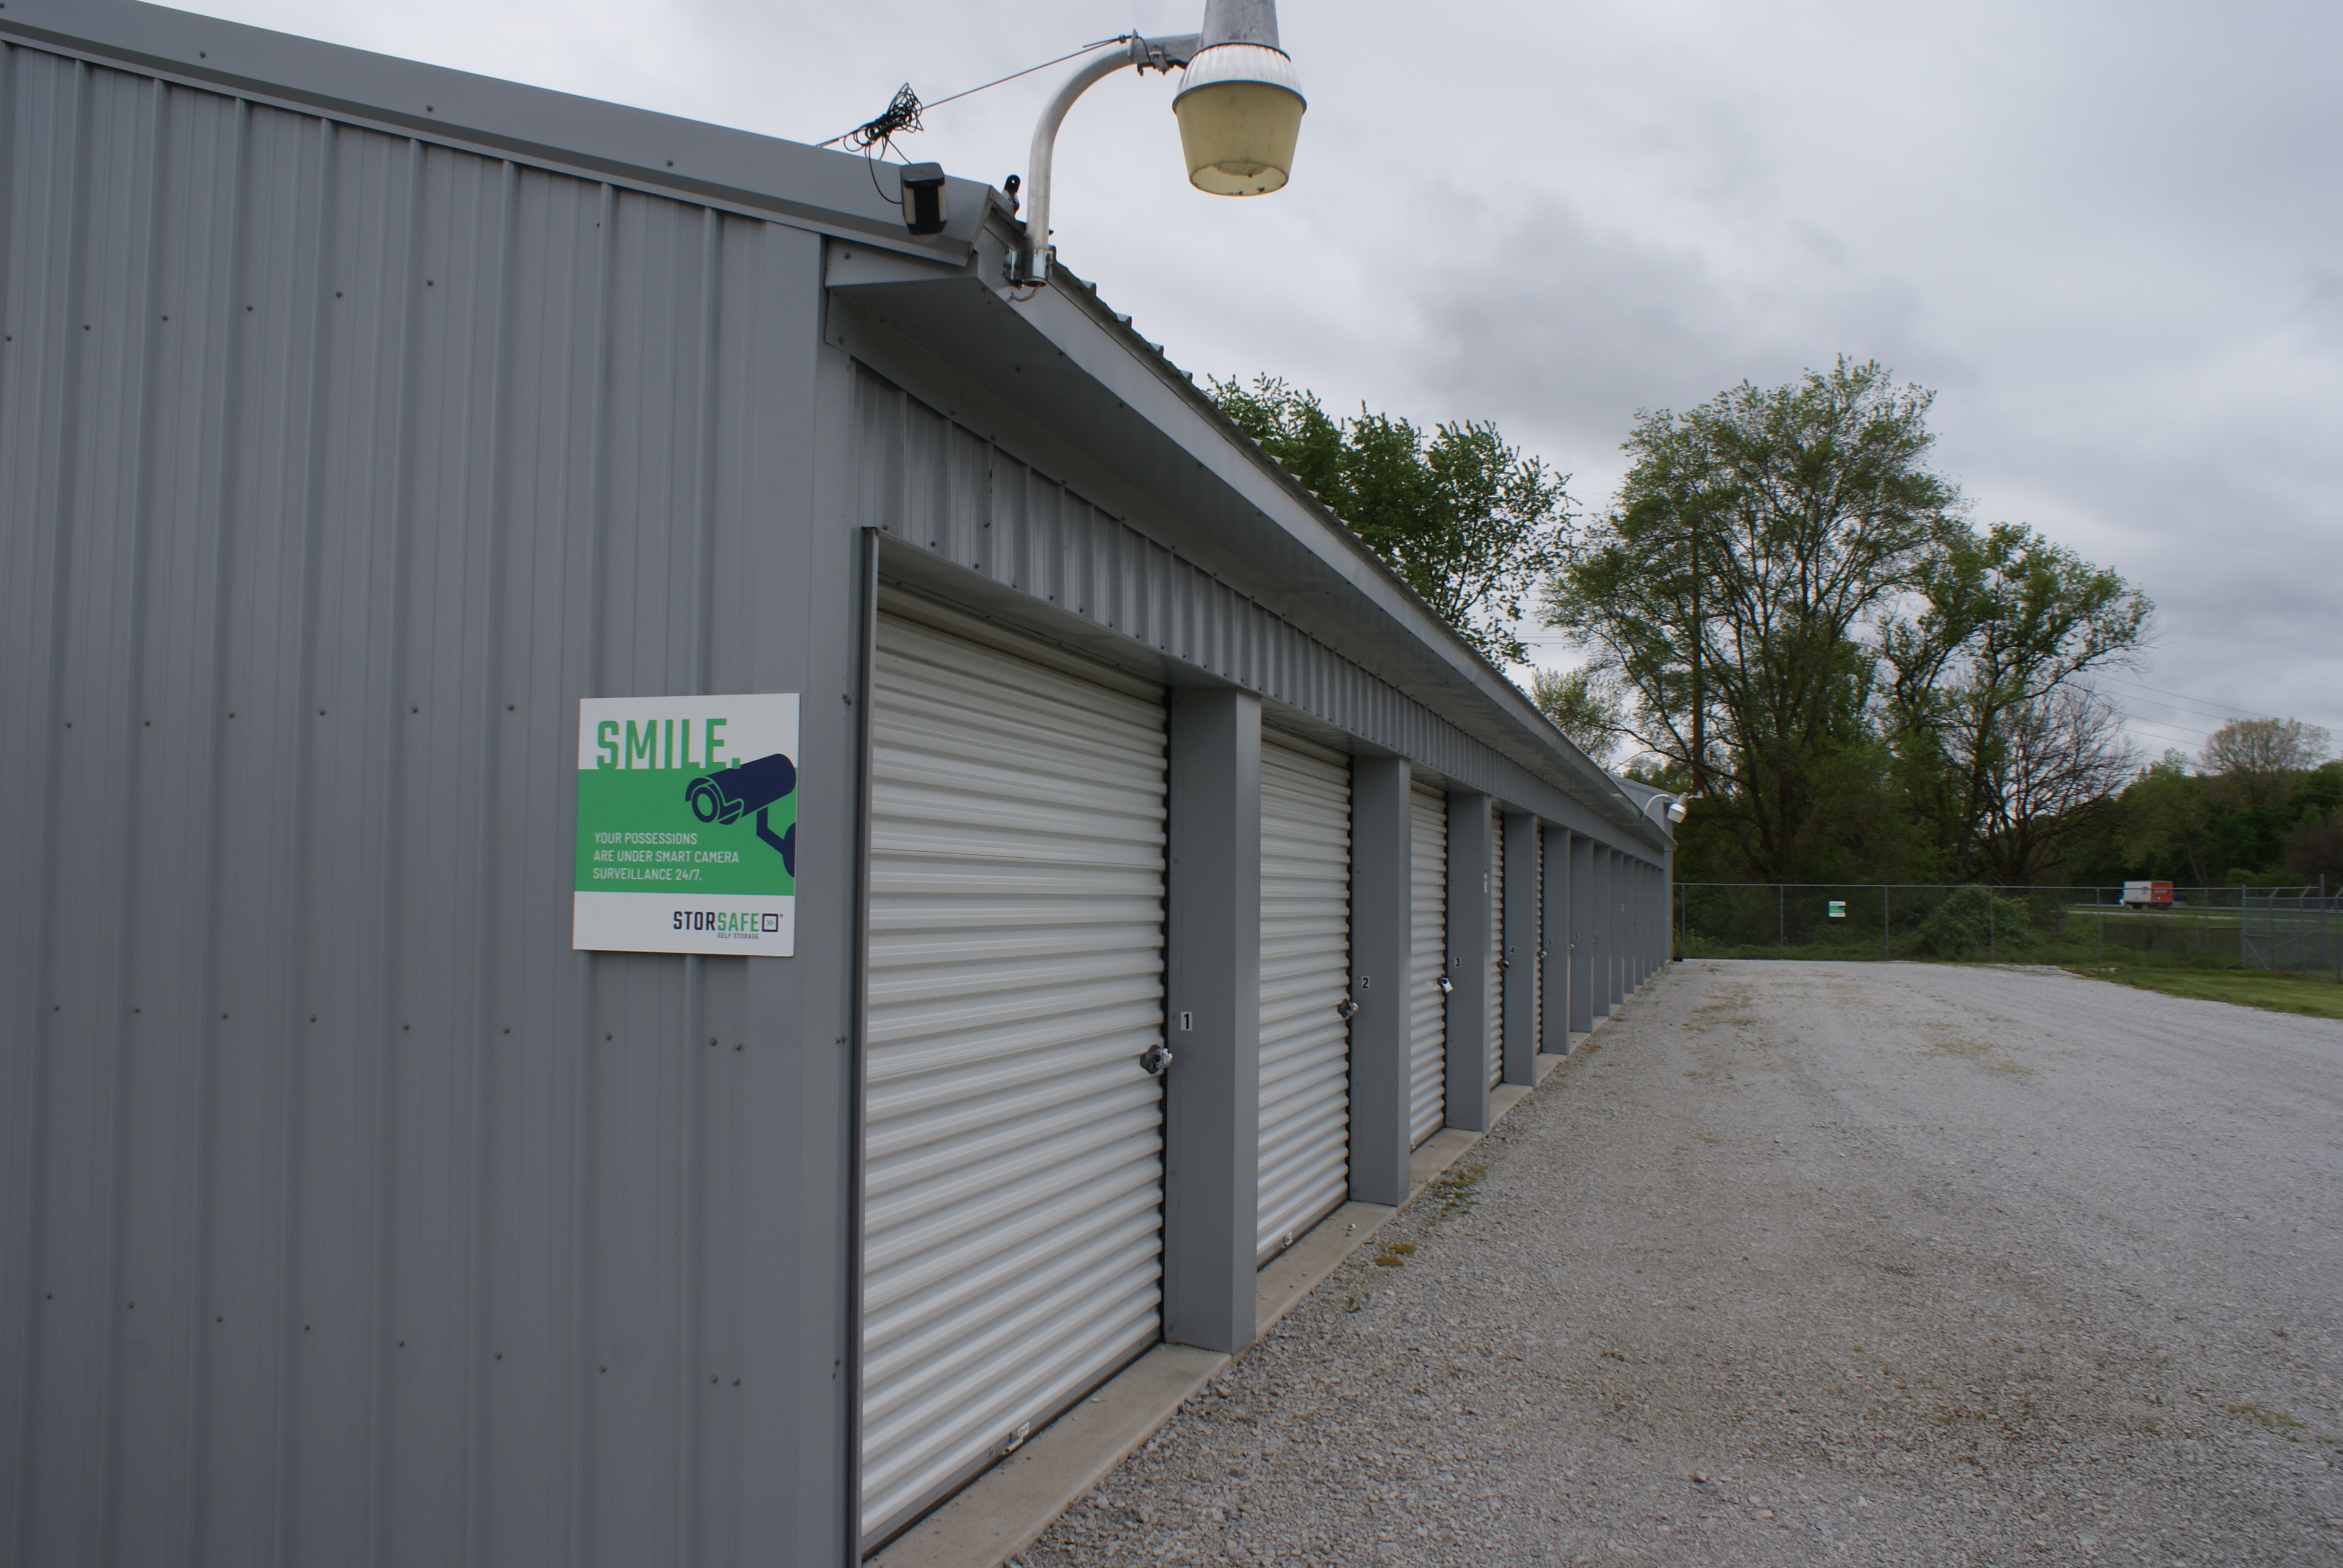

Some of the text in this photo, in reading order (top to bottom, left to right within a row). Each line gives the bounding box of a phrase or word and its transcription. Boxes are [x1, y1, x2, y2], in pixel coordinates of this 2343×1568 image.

[597, 717, 741, 769] SMILE.
[594, 832, 698, 844] YOUR POSSESSIONS
[594, 850, 739, 863] ARE UNDER SMART CAMERA
[593, 867, 702, 881] SURVEILLANCE 24/7.
[673, 911, 759, 932] STORSAFE
[1455, 958, 1460, 967] 3
[1363, 977, 1369, 988] 2
[1184, 1013, 1190, 1030] 1
